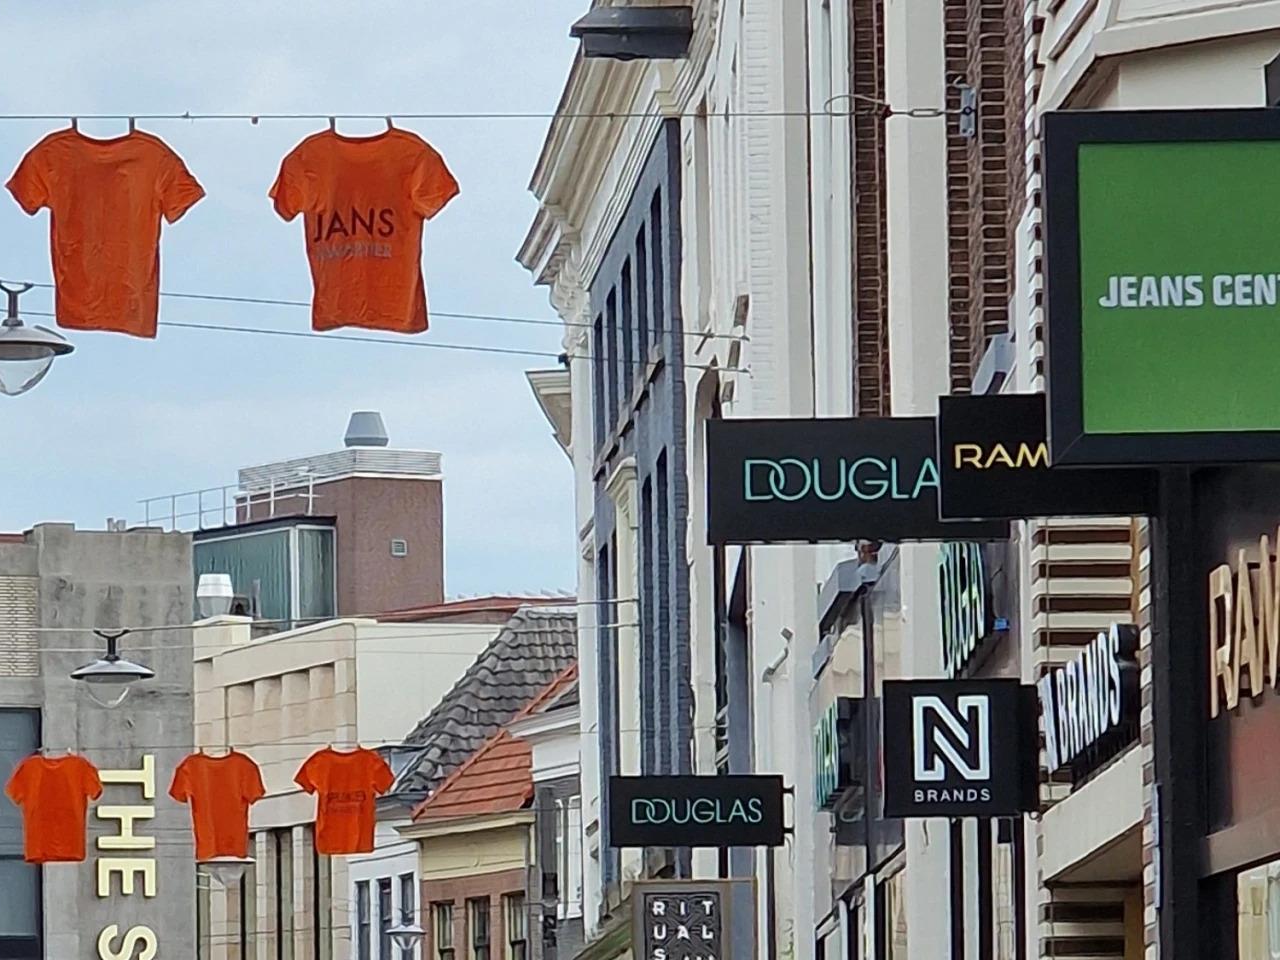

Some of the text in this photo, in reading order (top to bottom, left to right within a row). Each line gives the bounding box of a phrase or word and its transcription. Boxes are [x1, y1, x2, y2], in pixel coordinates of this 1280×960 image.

[313, 206, 395, 243] JANS
[1098, 274, 1280, 308] JEANS CEN
[1056, 622, 1121, 767] BRANDS
[913, 695, 991, 782] N
[631, 798, 763, 825] DOUGLAS
[914, 788, 992, 803] BRANDS
[96, 753, 158, 898] THE
